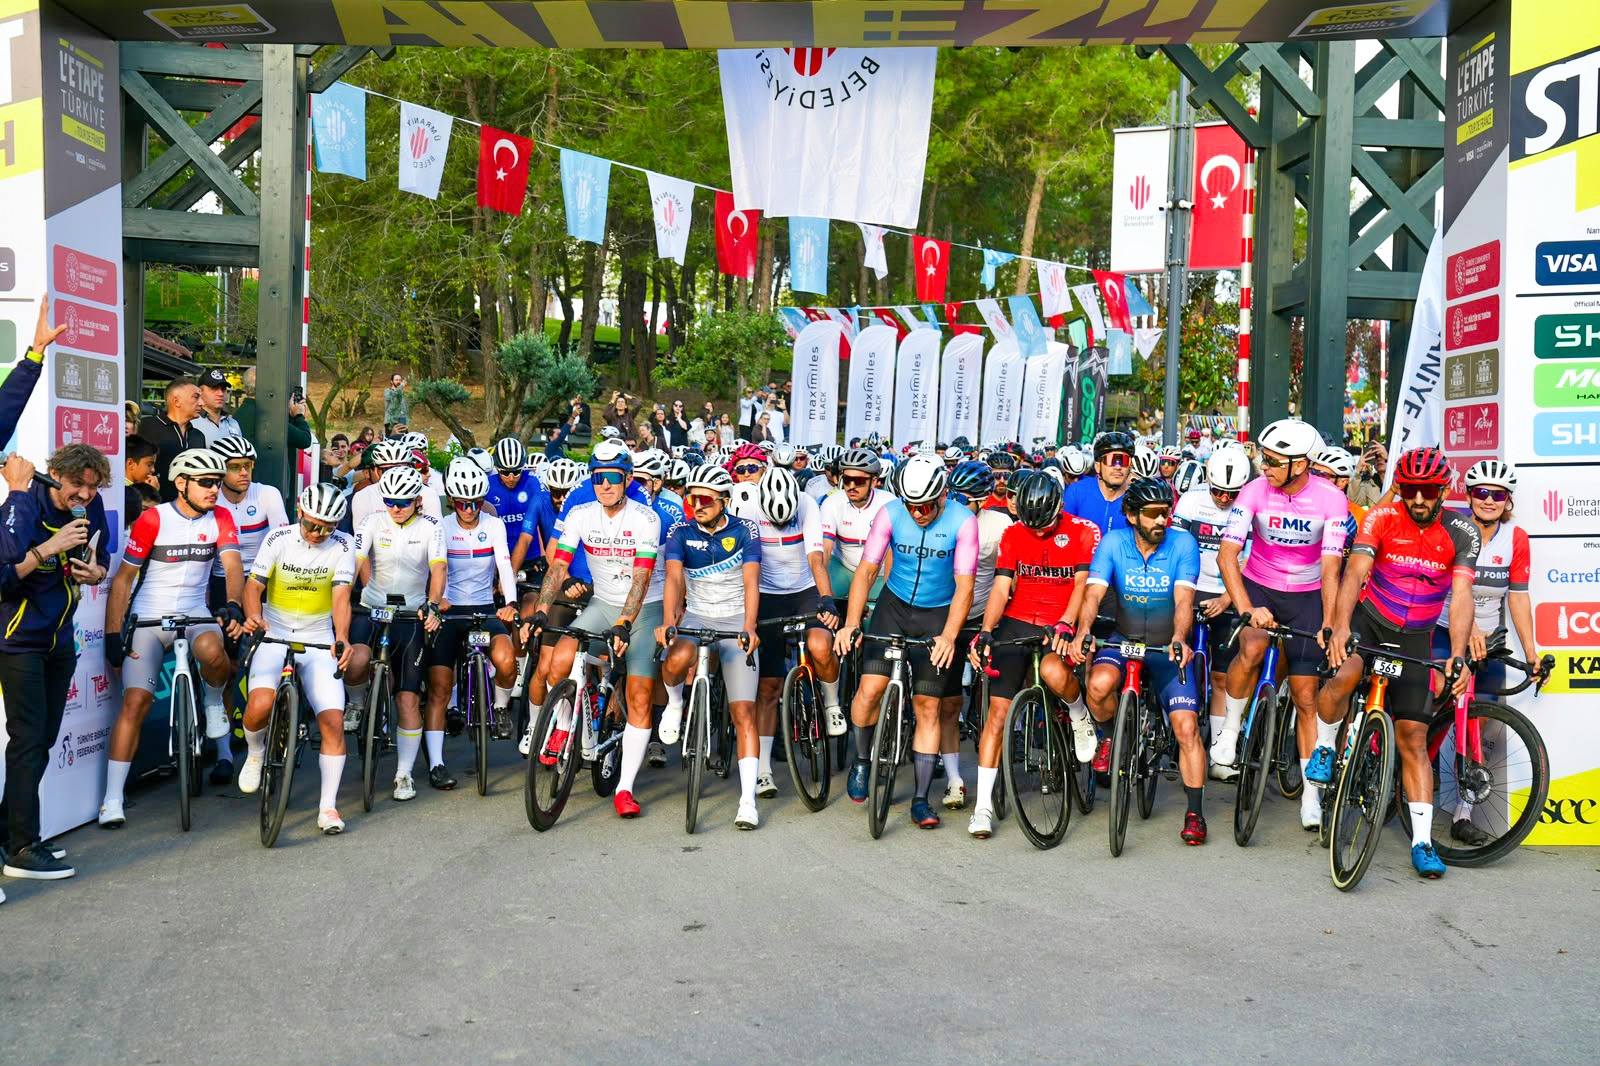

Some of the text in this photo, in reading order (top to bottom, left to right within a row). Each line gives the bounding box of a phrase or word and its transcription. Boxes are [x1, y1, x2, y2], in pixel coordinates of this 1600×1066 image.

[1542, 253, 1598, 273] VISA
[807, 347, 819, 420] maximiles
[863, 352, 876, 421] maximiles
[910, 353, 921, 419] maximiles
[954, 357, 965, 420] maximiles
[996, 362, 1008, 421] maximiles
[1268, 516, 1312, 532] RMK
[355, 533, 363, 550] VISA
[1268, 535, 1311, 544] TREK
[1386, 552, 1447, 570] MARMARA
[1125, 574, 1170, 588] K30.8
[375, 610, 390, 619] 910
[472, 634, 487, 643] 566
[1124, 646, 1141, 655] 834
[1380, 661, 1397, 674] 565
